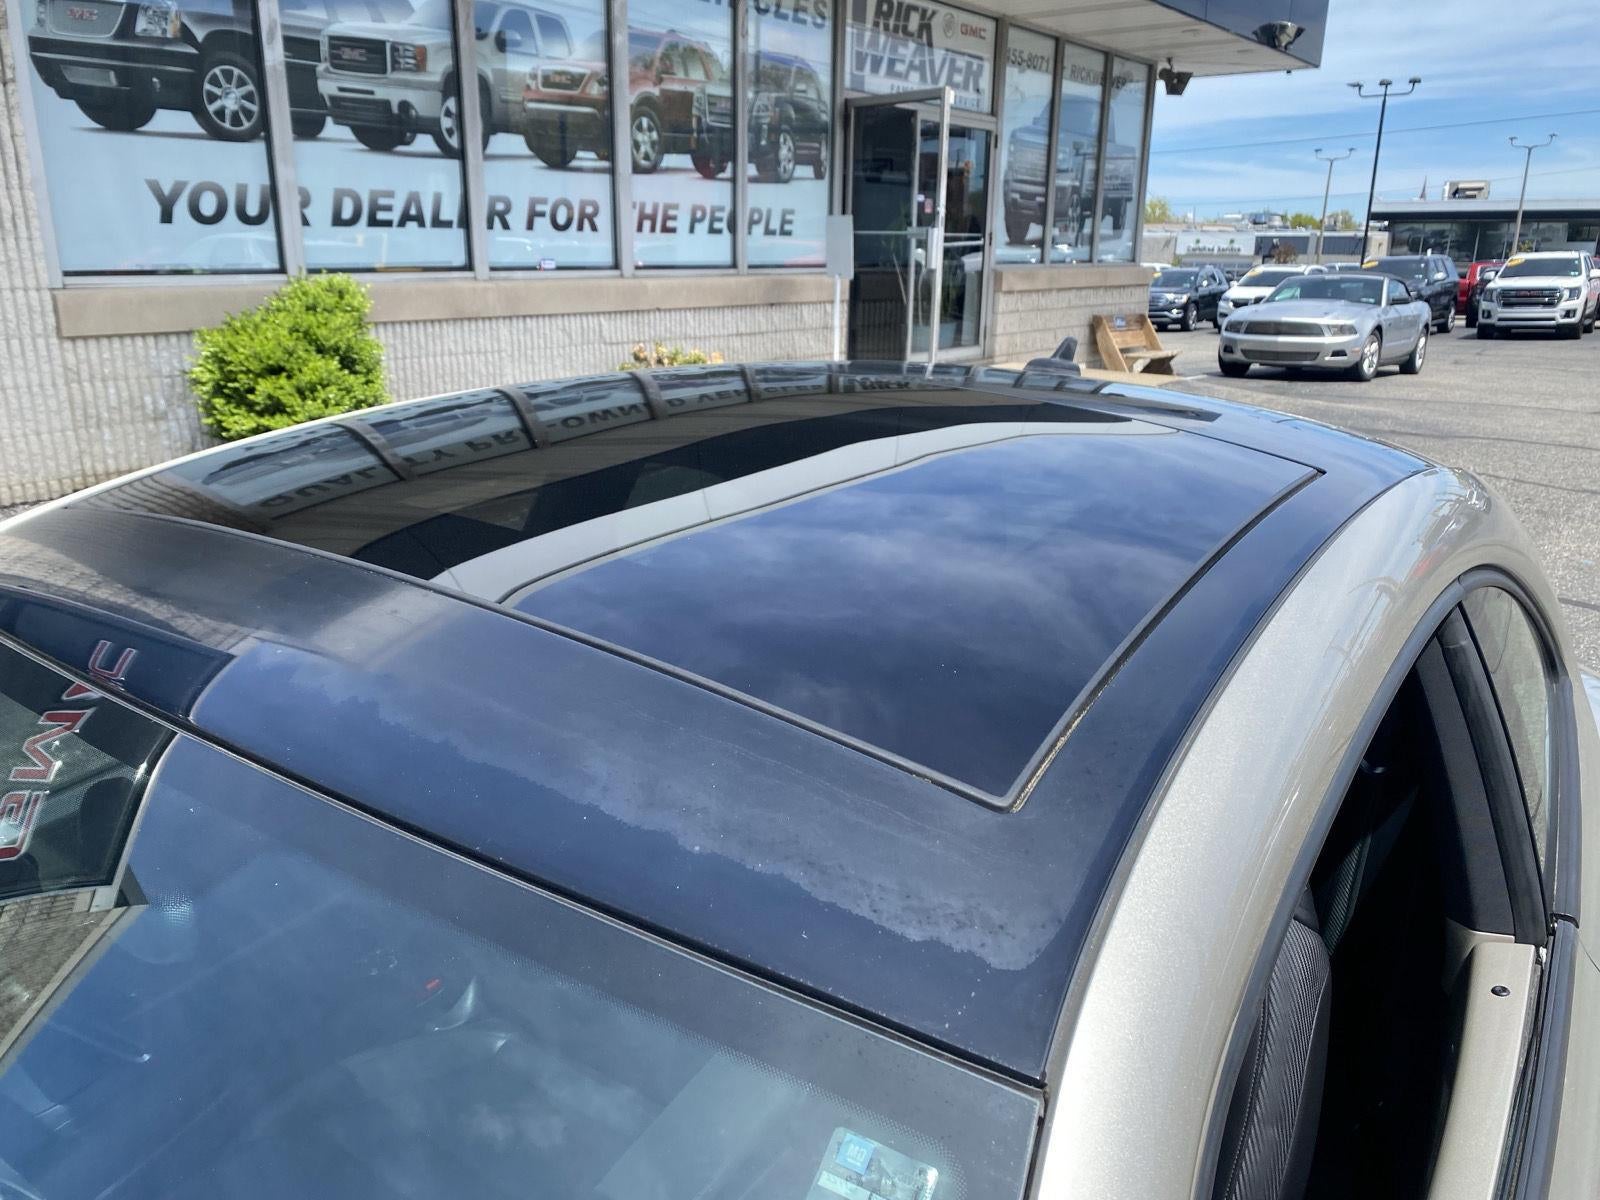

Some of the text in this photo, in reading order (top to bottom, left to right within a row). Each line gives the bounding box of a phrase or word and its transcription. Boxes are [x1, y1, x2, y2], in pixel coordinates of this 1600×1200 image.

[872, 0, 938, 48] RICK
[960, 23, 987, 40] GMC
[854, 28, 985, 94] WEAVER
[526, 196, 599, 232] FOR
[632, 202, 679, 234] HE
